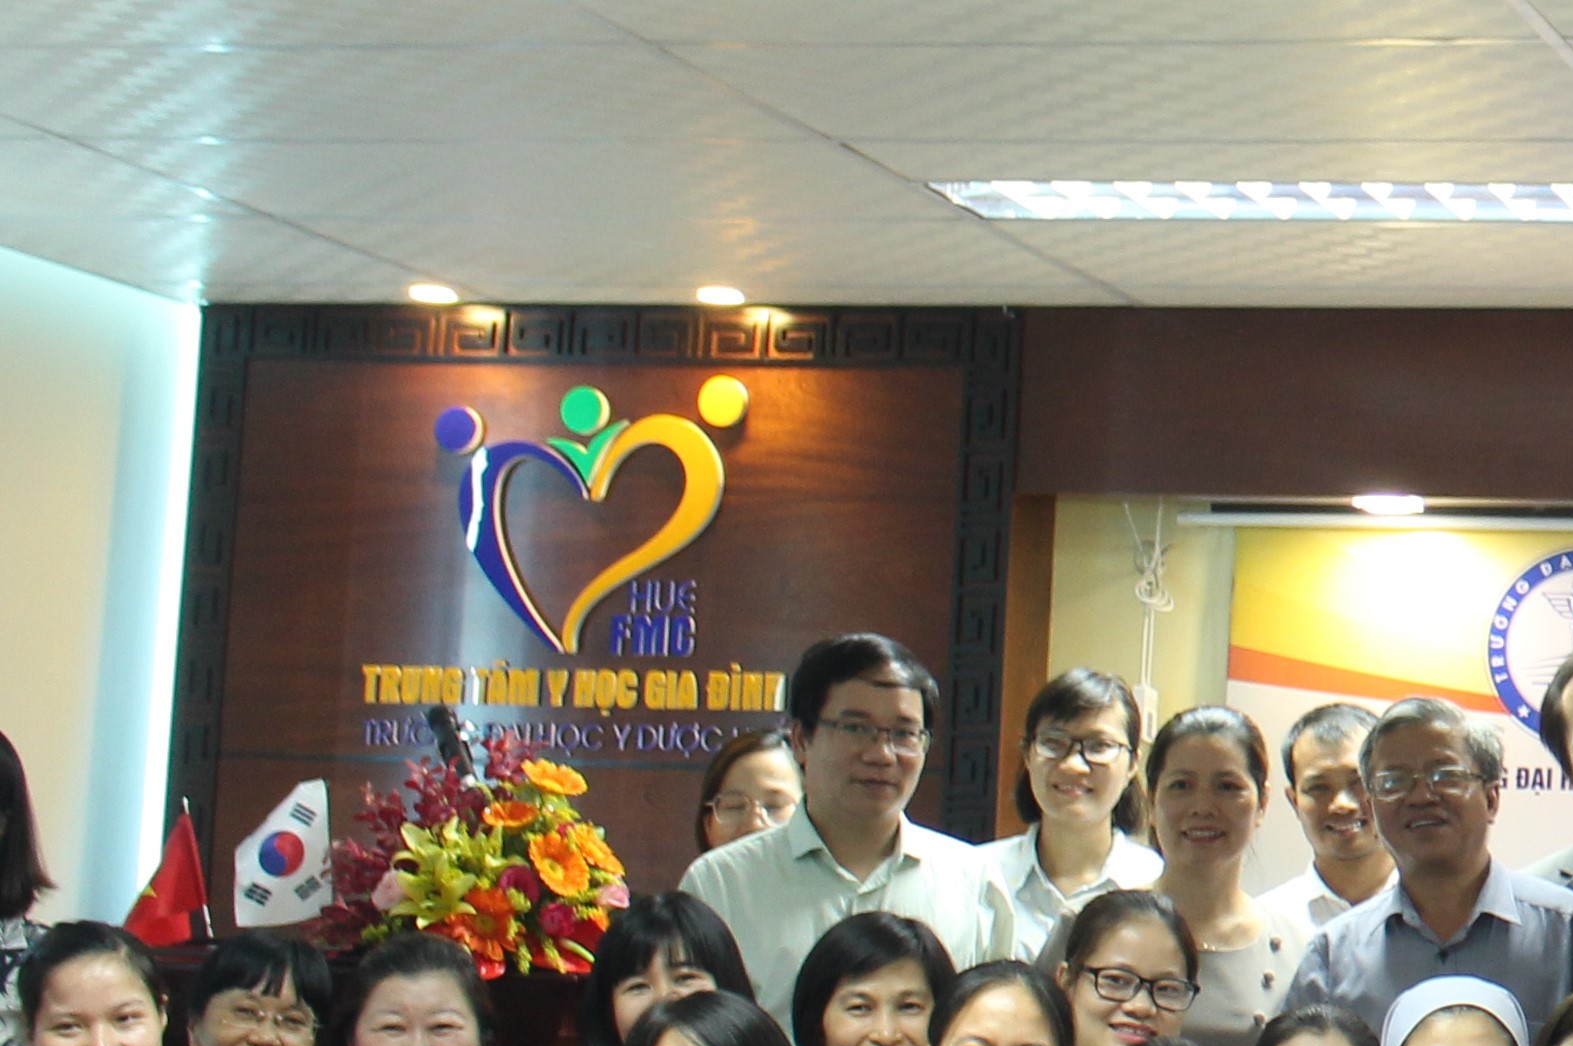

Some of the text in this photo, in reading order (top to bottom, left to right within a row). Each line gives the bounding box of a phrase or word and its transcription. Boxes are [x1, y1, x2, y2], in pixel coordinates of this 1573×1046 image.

[628, 579, 697, 614] HUE
[610, 613, 697, 658] FMC
[362, 663, 465, 705] TRUNG
[468, 660, 541, 708] TÂM
[546, 668, 570, 707] Y
[573, 667, 639, 718] HỌC
[643, 669, 699, 711] GIA
[612, 723, 632, 751] Y
[1516, 767, 1553, 796] ĐẠI
